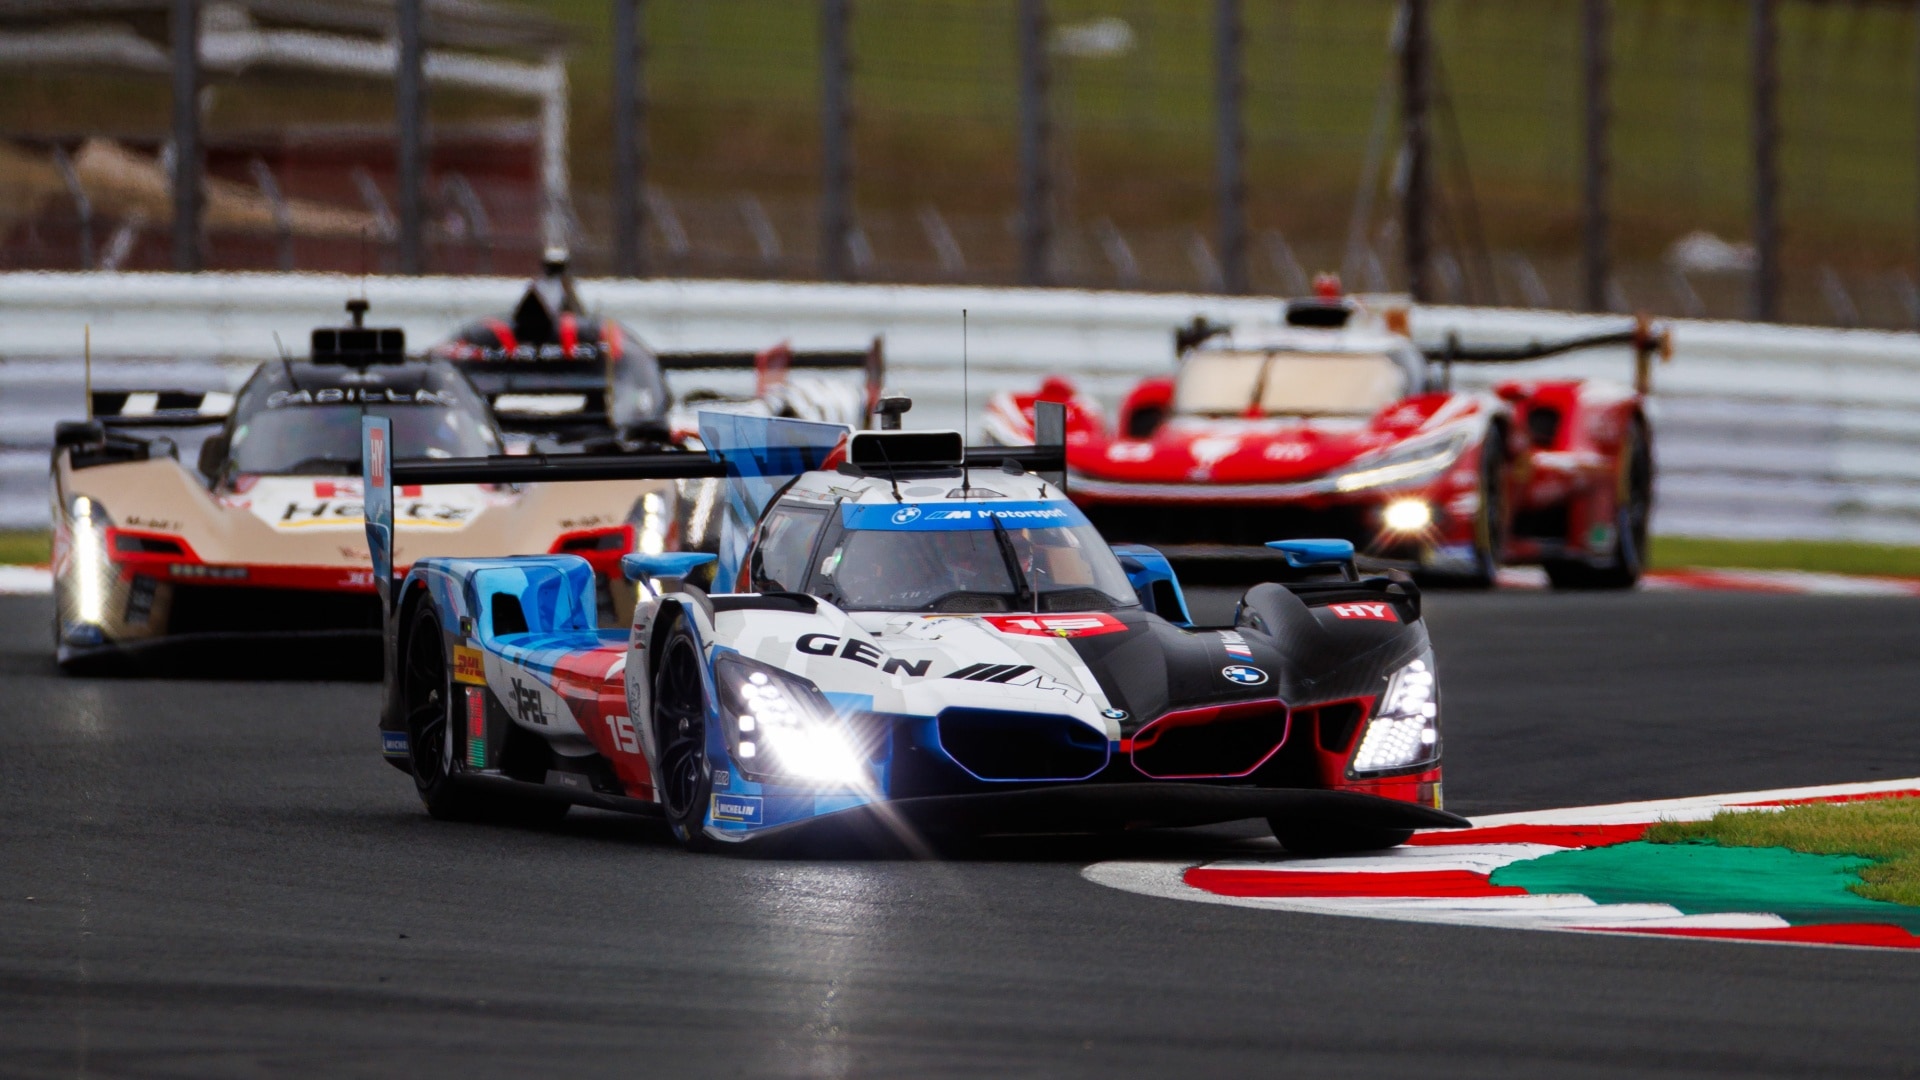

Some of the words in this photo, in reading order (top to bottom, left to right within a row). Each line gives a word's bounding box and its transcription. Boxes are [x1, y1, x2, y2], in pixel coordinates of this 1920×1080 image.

[371, 439, 383, 477] HY
[281, 503, 473, 520] Hetz
[978, 509, 1067, 519] Motorsport
[1333, 605, 1385, 618] HY
[1005, 617, 1104, 630] 15
[795, 633, 933, 677] GEN
[510, 677, 549, 725] XPEL
[605, 714, 640, 755] 15
[719, 803, 755, 816] MICHELIN
